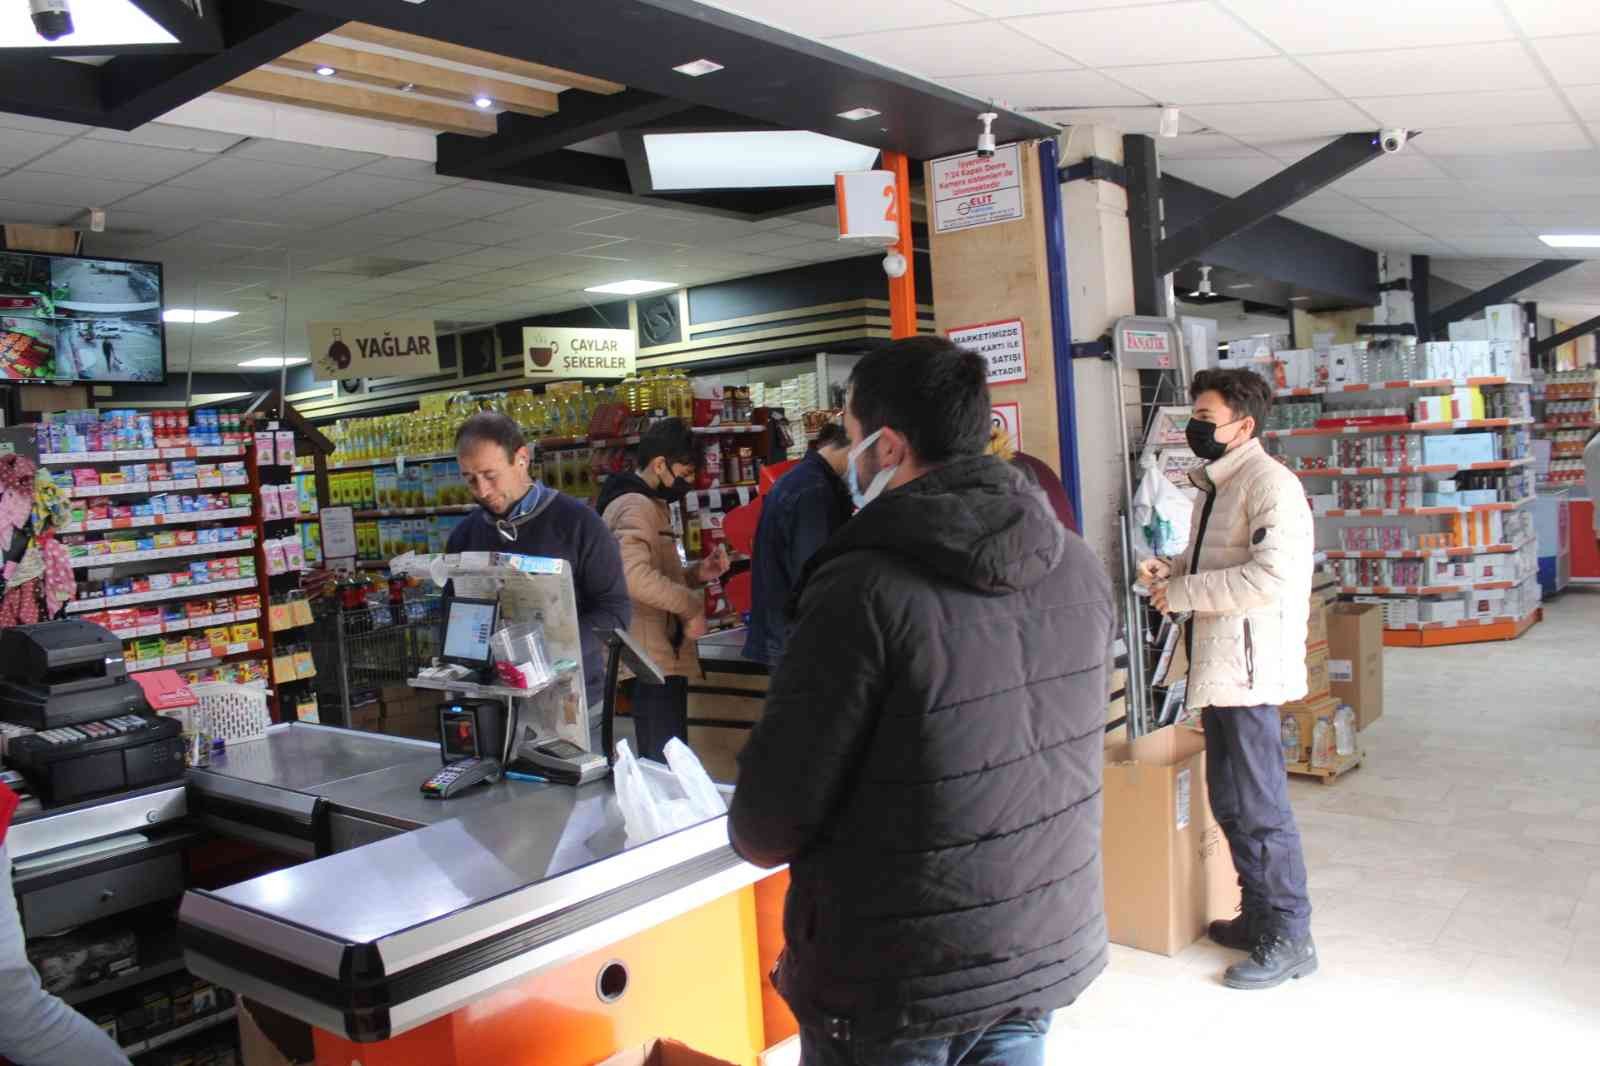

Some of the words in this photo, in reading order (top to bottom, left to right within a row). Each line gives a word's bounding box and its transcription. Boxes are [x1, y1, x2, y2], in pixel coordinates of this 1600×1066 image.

[883, 185, 897, 221] 2
[355, 328, 432, 359] YAĞLAR
[953, 327, 1018, 344] MARKETİMİZDE
[570, 338, 618, 354] ÇAYLAR
[563, 355, 626, 372] ŞEKERLER
[991, 352, 1021, 365] SATIŞI
[984, 365, 1023, 378] AKTADIR
